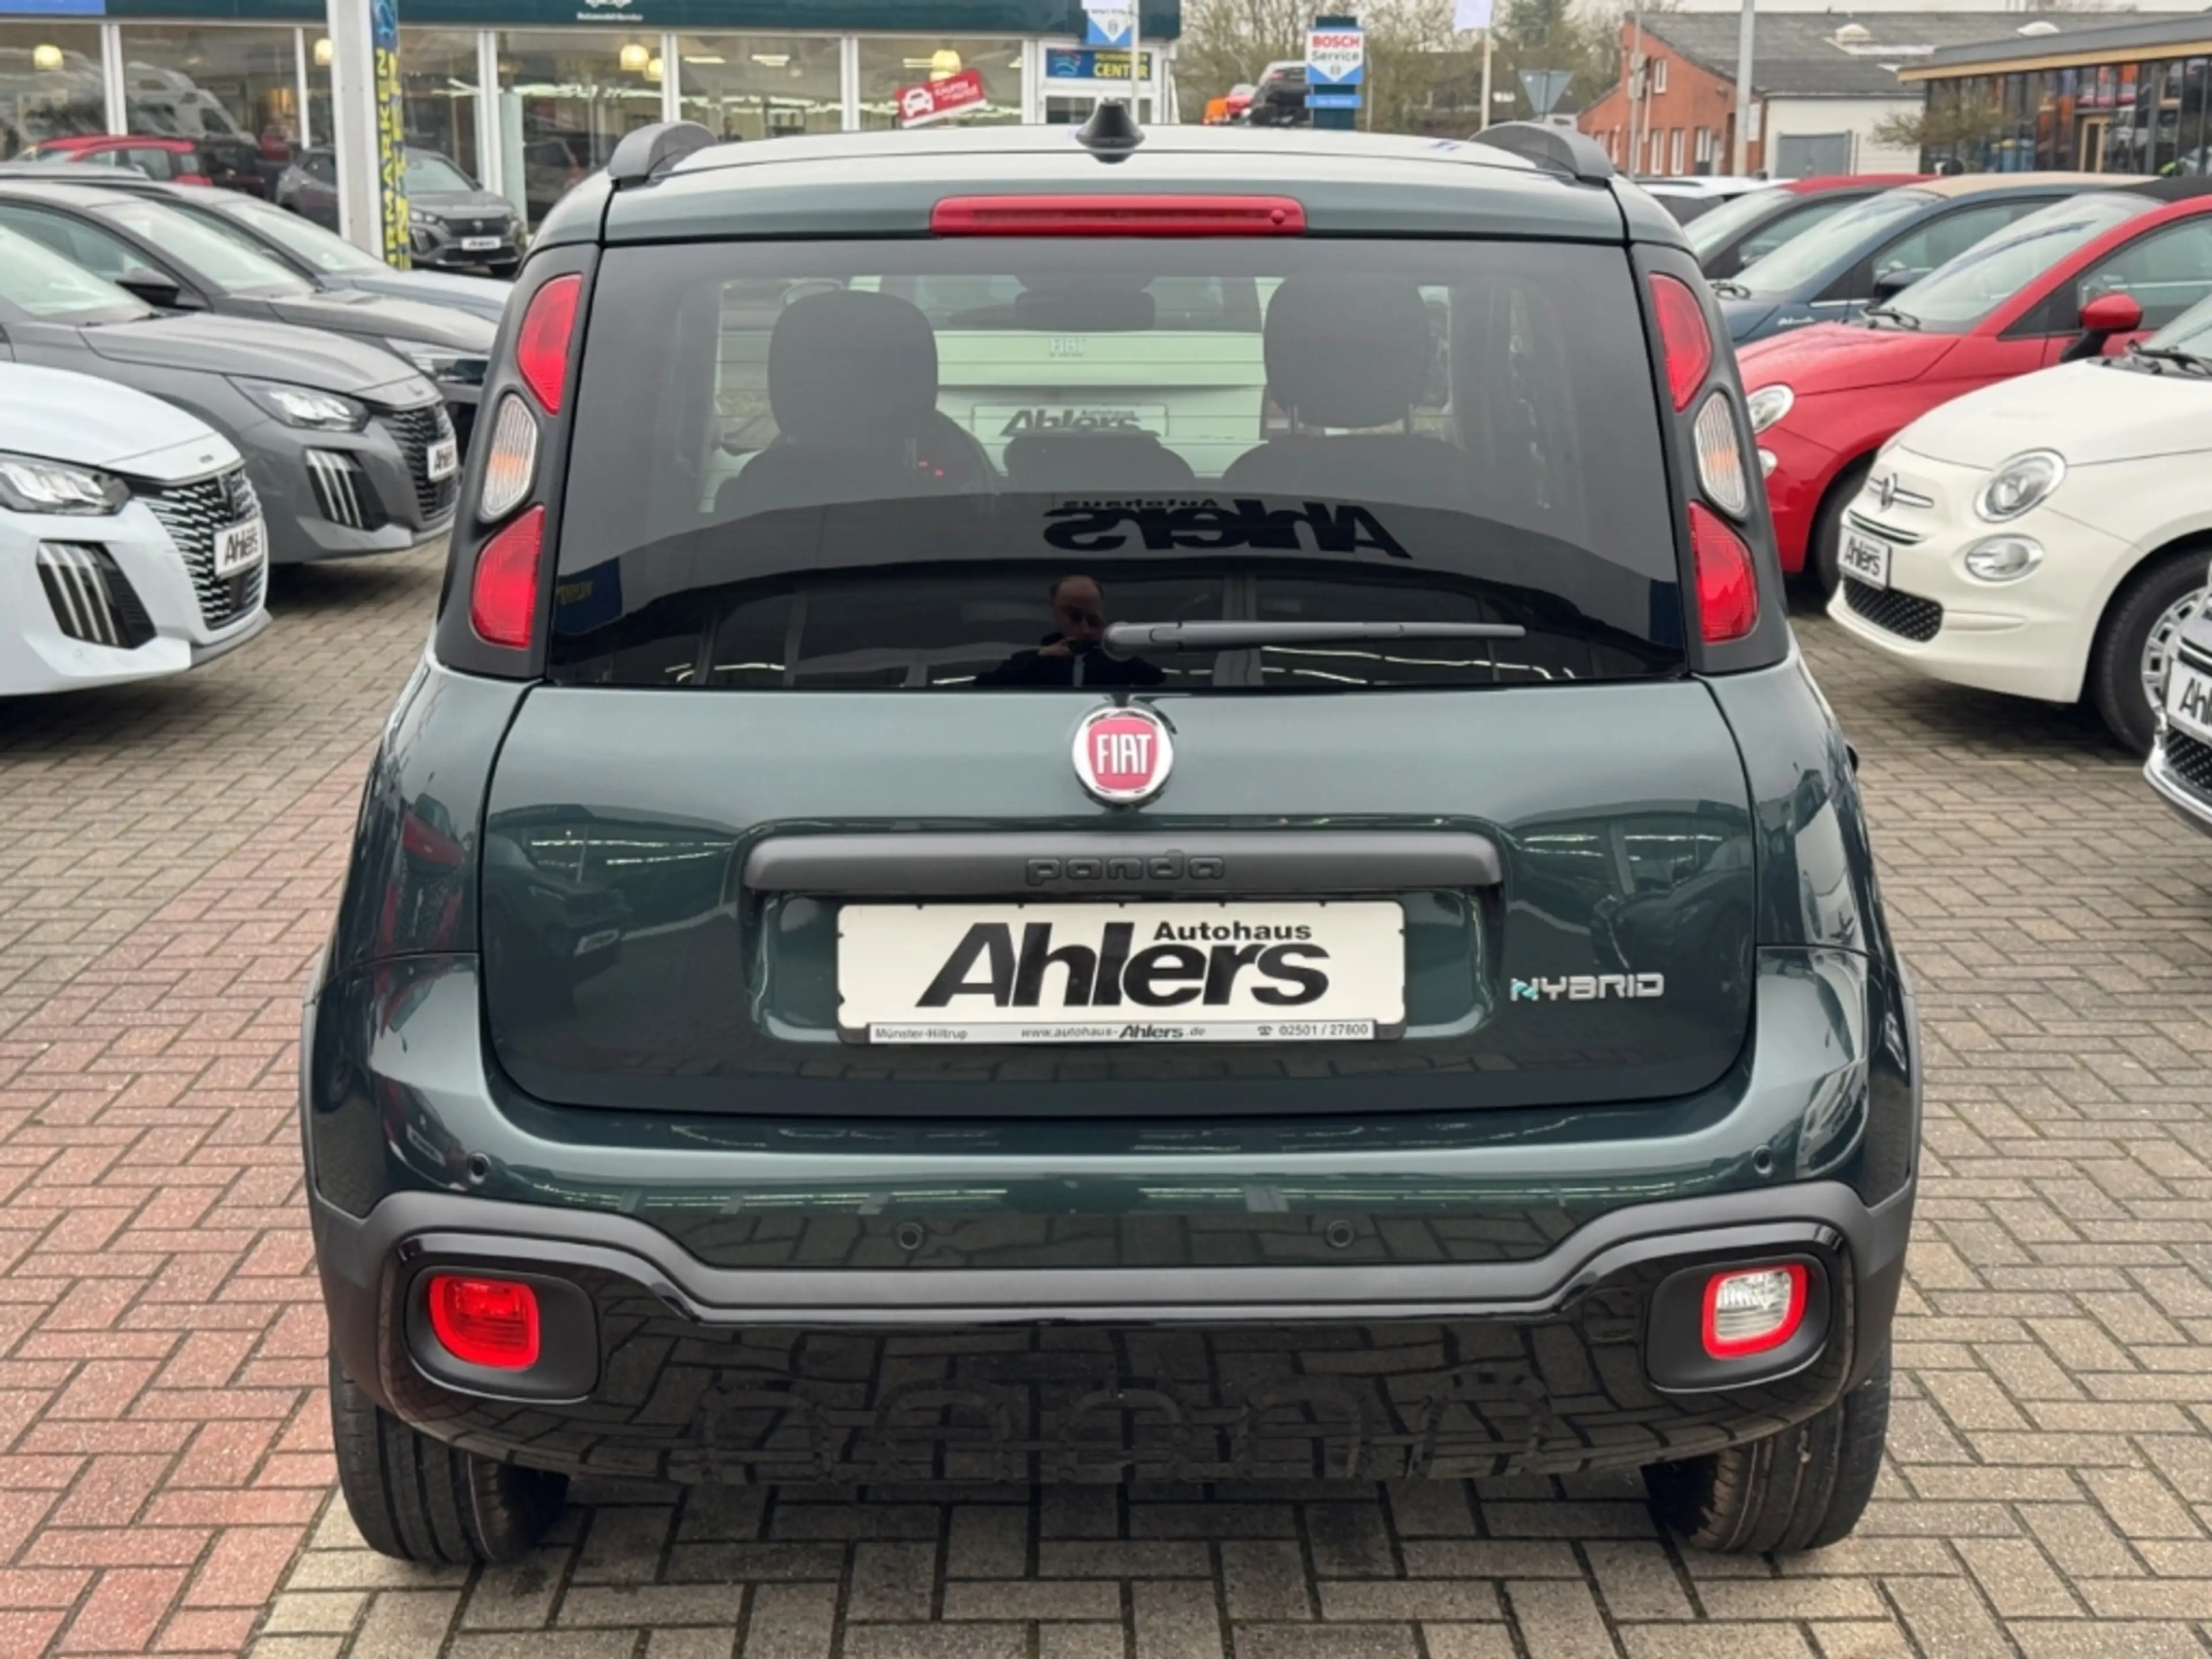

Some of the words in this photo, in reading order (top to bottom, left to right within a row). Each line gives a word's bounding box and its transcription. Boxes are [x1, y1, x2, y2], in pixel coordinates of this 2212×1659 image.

[1312, 35, 1360, 48] BOSCH
[1312, 50, 1359, 61] Service
[1094, 62, 1148, 78] CENTR
[1844, 536, 1881, 577] Ahlers
[1097, 734, 1152, 774] FIAT
[1027, 849, 1225, 887] panda
[1153, 922, 1312, 940] Autohaus
[915, 922, 1330, 1006] Ahlers
